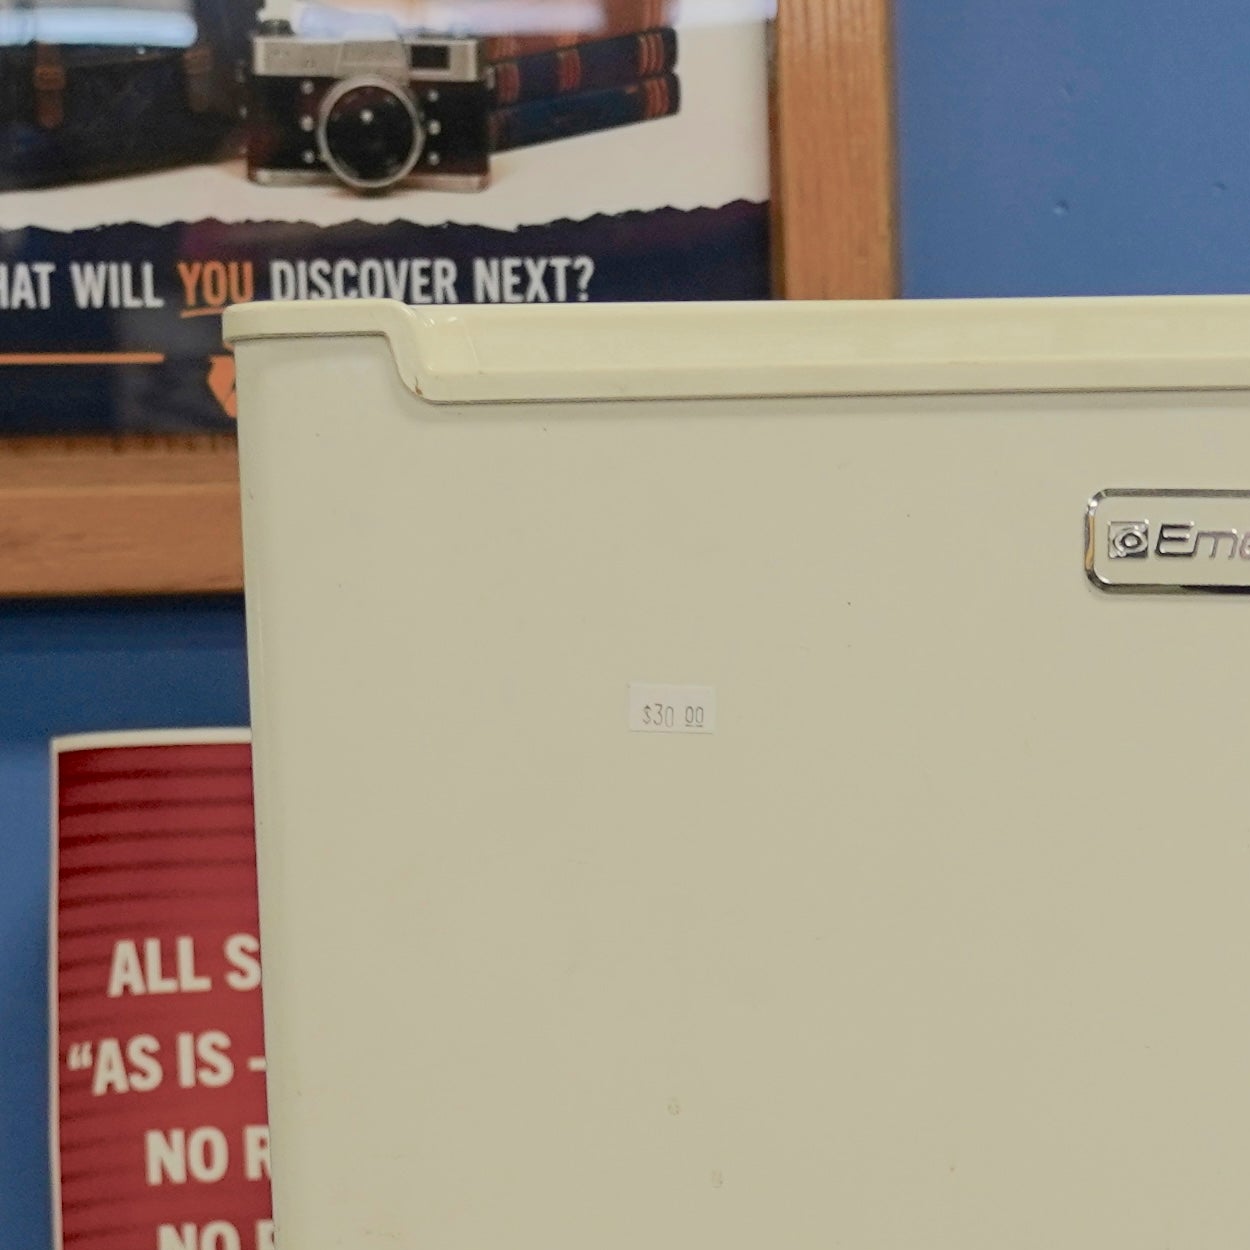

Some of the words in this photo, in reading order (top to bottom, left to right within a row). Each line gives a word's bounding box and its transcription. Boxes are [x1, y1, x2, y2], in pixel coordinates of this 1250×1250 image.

[69, 261, 165, 309] WILL
[177, 261, 254, 306] YOU
[270, 257, 458, 303] DISCOVER
[473, 256, 595, 303] NEXT?
[107, 935, 213, 998] ALL
[176, 1030, 235, 1089] IS
[145, 1125, 229, 1186] NO
